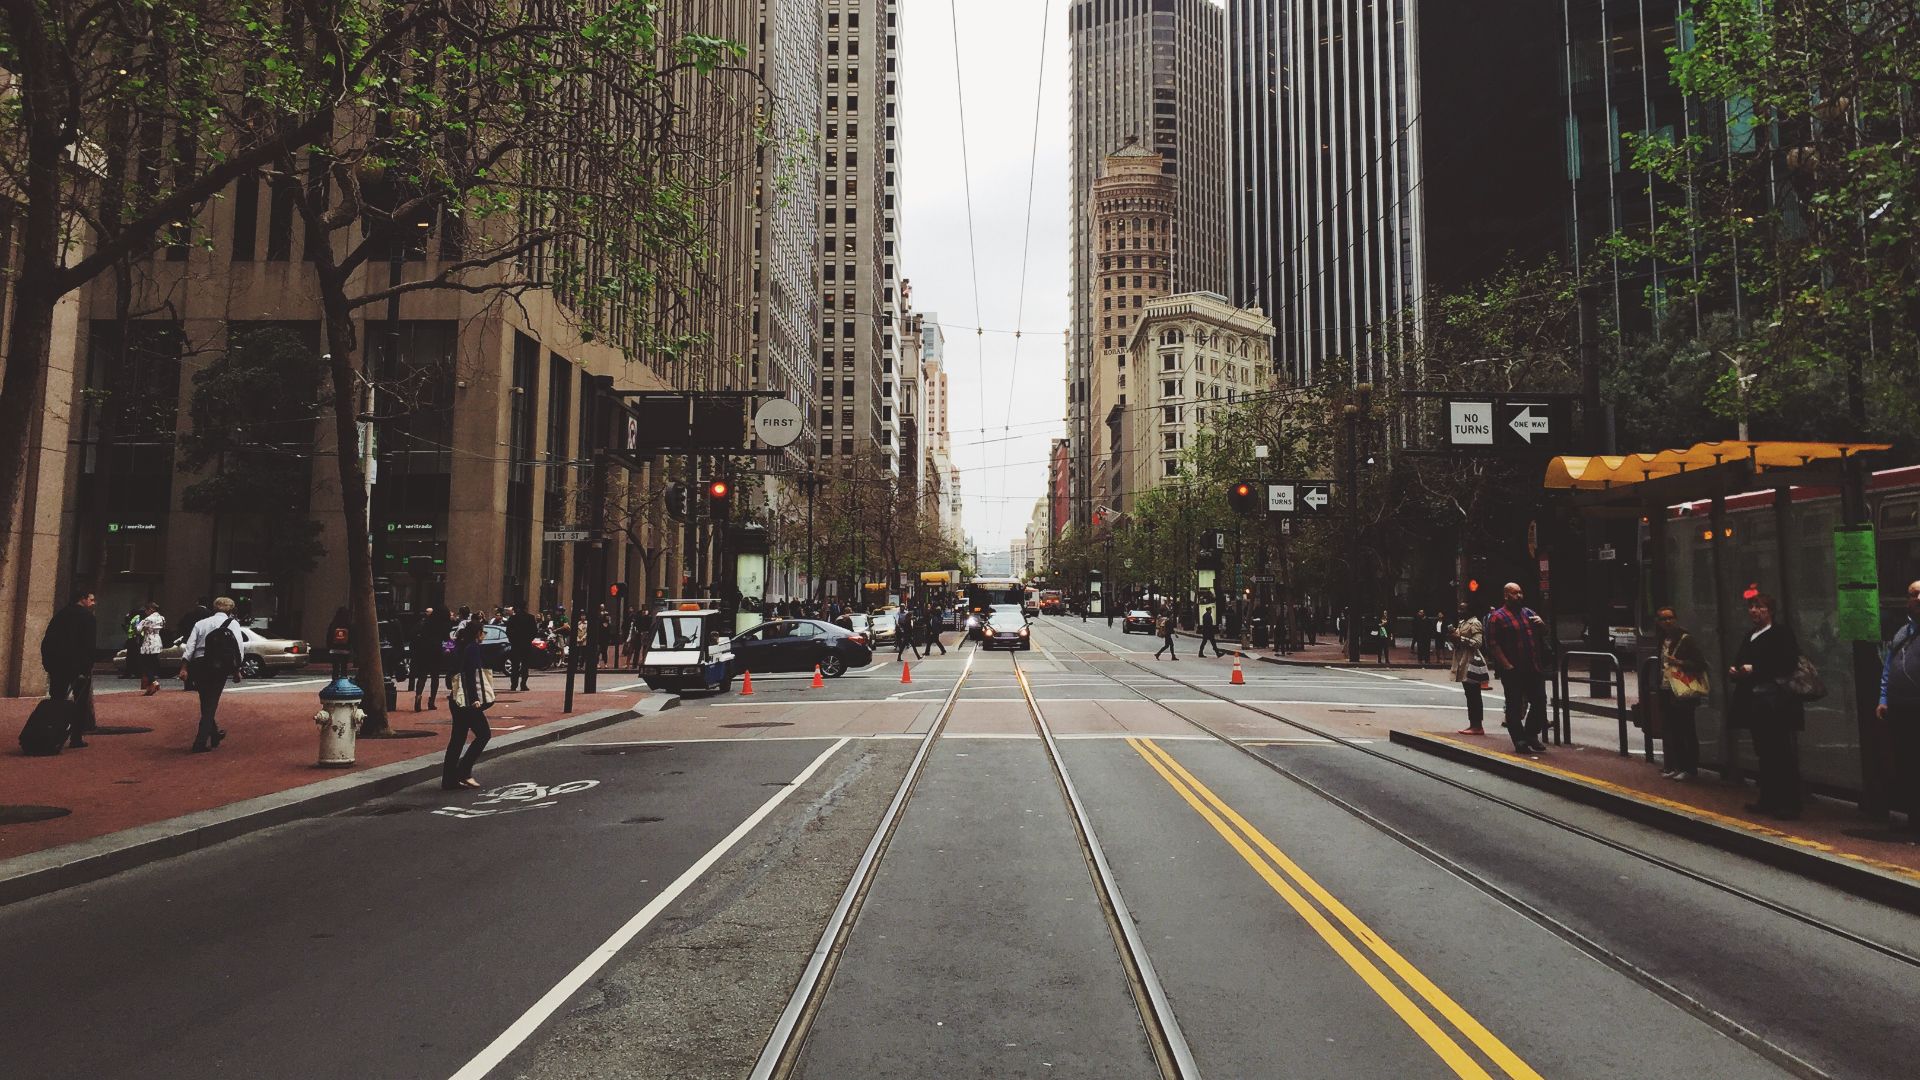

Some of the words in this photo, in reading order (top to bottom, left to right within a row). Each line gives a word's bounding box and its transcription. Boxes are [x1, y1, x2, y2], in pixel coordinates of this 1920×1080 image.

[763, 418, 794, 427] FIRST
[1464, 413, 1478, 423] NO
[1454, 425, 1489, 434] TURNS
